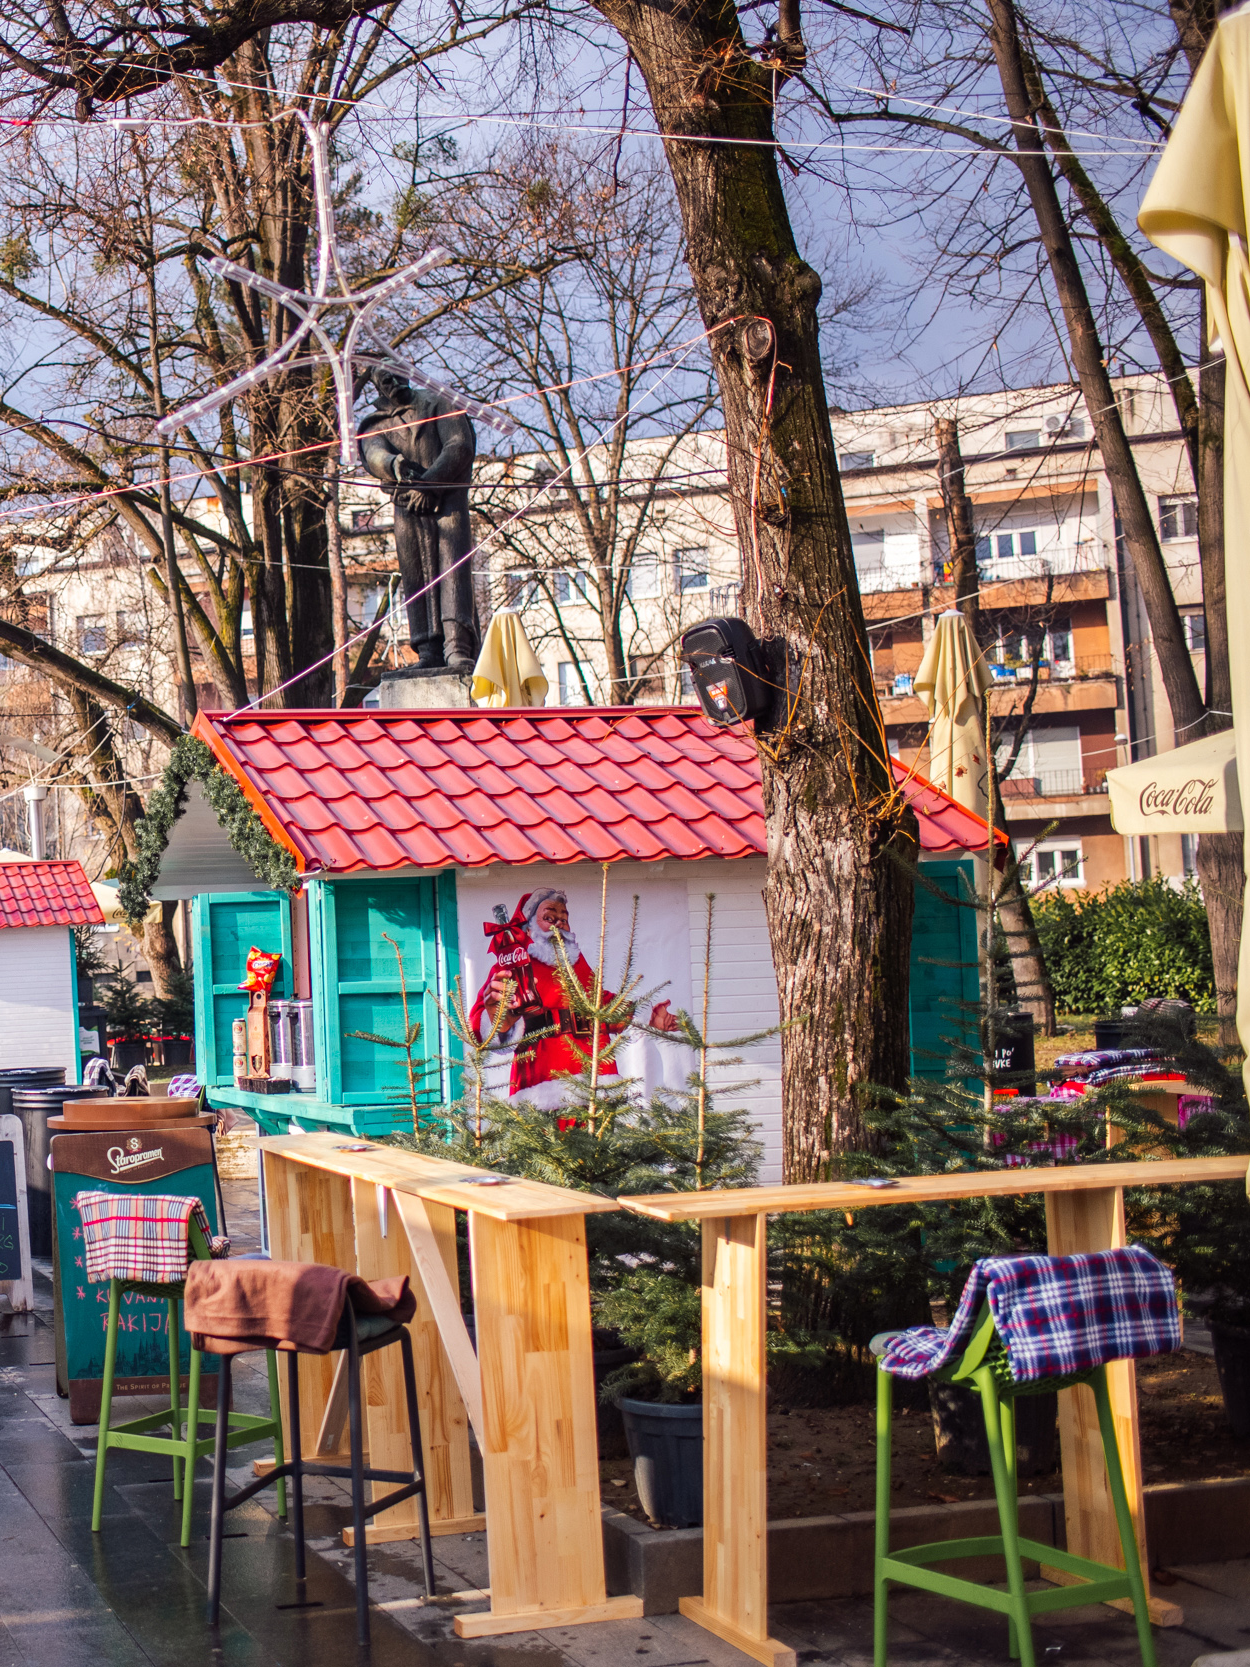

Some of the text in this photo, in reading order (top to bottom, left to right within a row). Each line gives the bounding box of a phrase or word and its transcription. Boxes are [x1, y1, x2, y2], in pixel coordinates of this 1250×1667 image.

[1140, 779, 1220, 816] Coca-Cola
[498, 946, 528, 967] Coca-Cola
[107, 1146, 165, 1175] Staropramen
